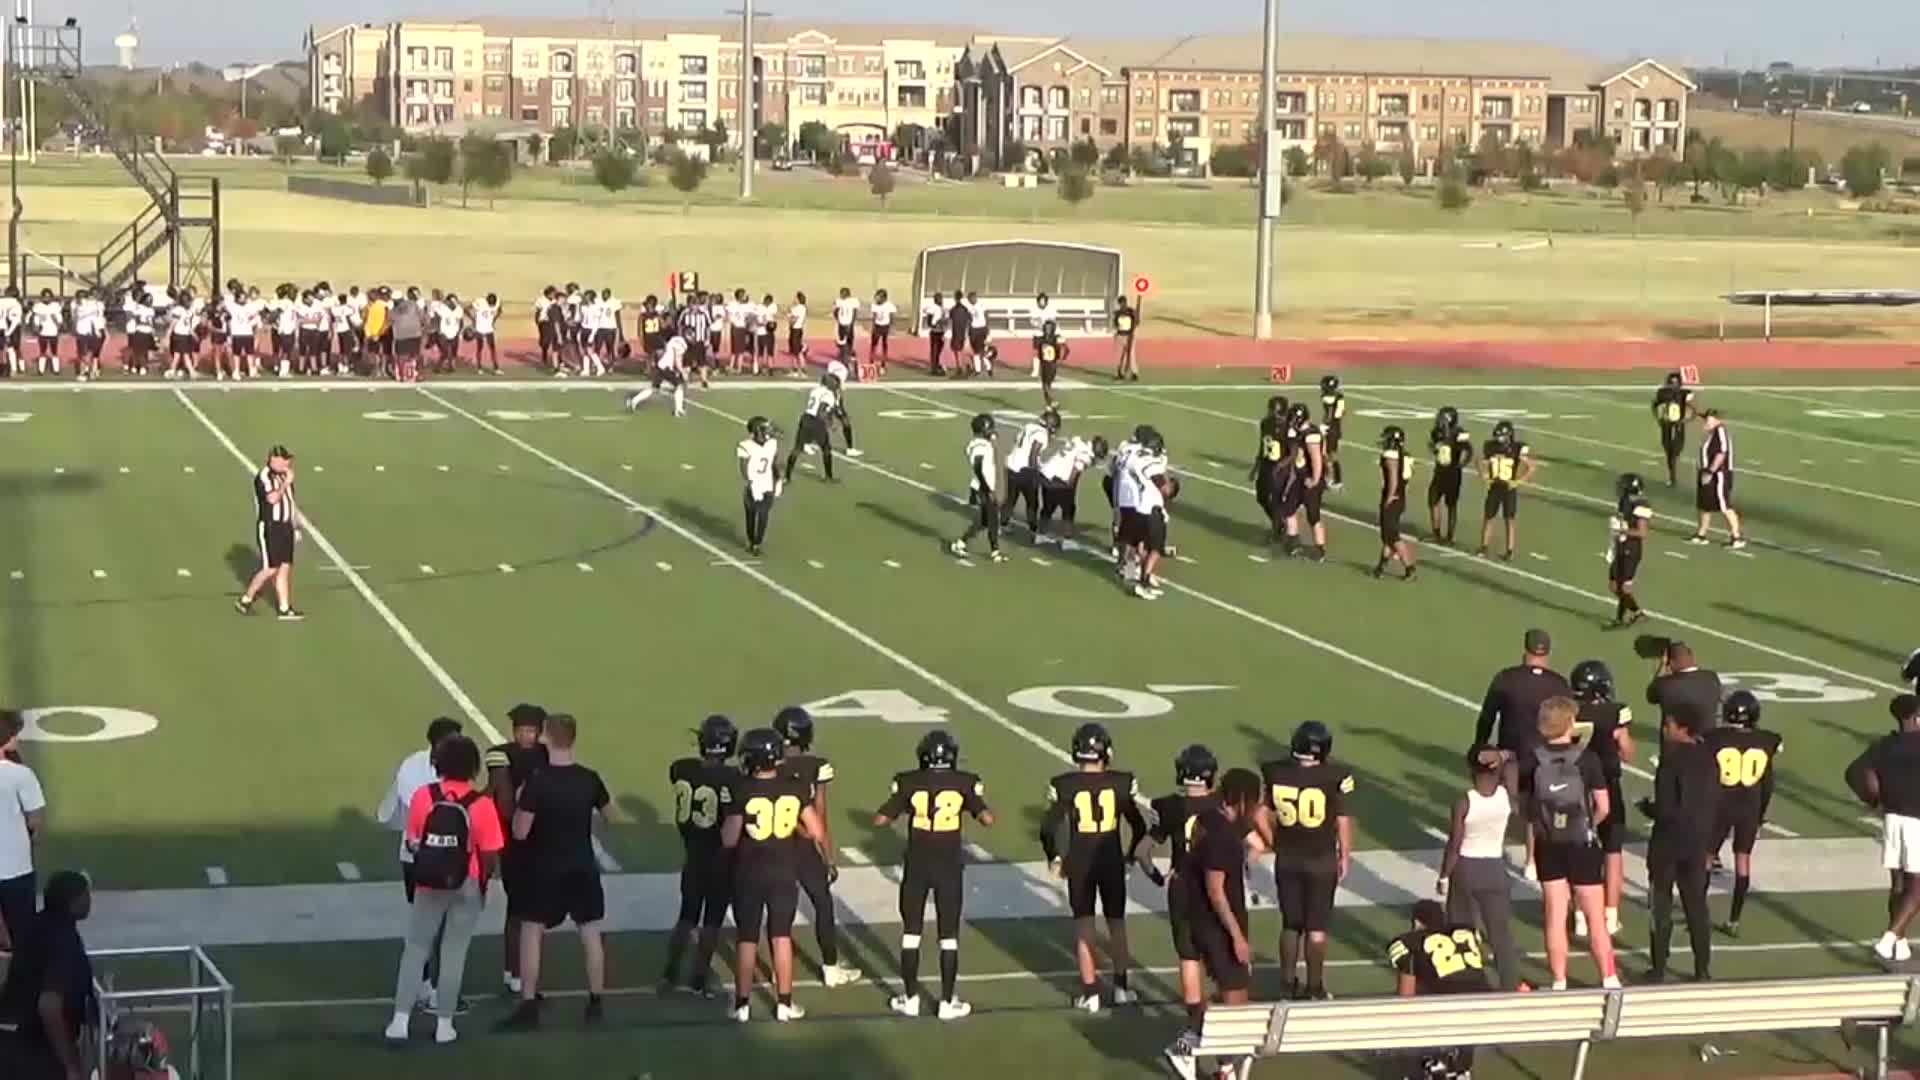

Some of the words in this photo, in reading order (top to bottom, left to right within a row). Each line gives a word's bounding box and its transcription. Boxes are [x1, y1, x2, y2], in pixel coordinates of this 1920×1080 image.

[681, 271, 697, 291] 2
[745, 795, 801, 840] 38
[910, 789, 964, 832] 12
[1074, 788, 1117, 833] 11
[1271, 784, 1327, 829] 50
[1423, 928, 1484, 978] 23
